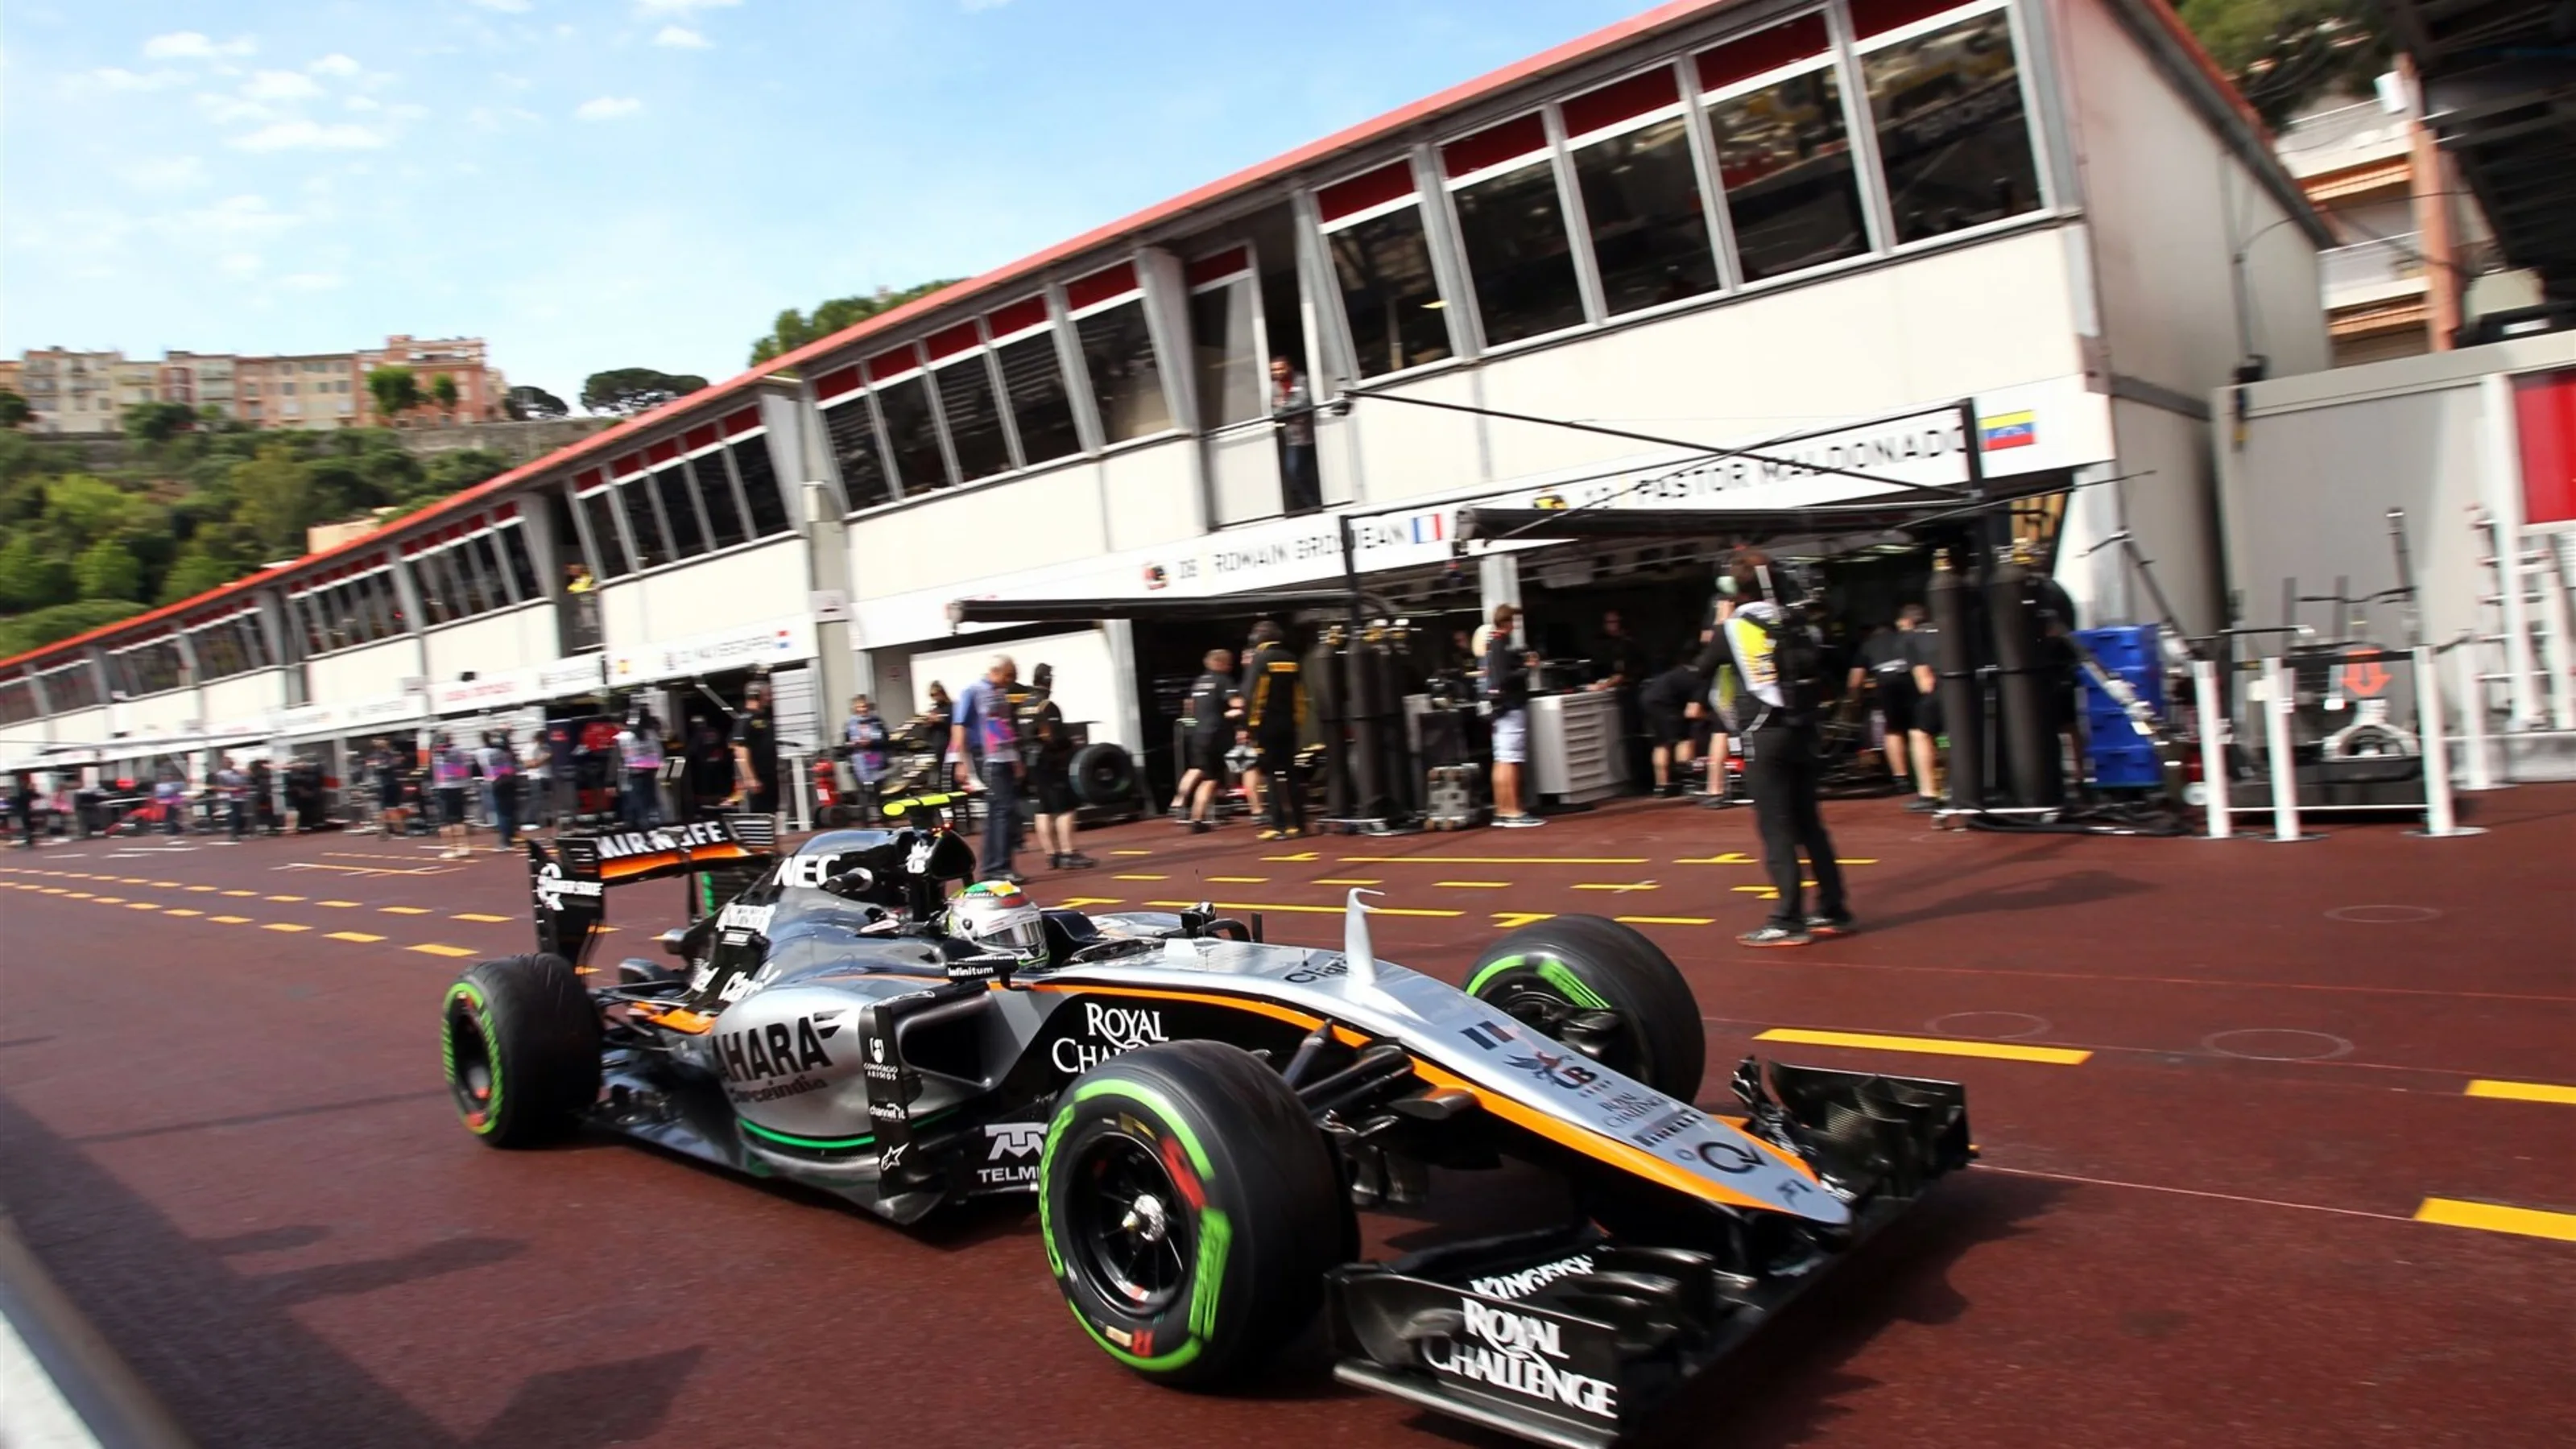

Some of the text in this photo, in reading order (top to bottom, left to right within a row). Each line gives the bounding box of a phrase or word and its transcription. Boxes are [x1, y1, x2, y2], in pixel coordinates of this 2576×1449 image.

[1637, 461, 1751, 504] PASTOR
[1296, 525, 1408, 560] GROJEAN
[773, 855, 841, 888] NEC
[1085, 1002, 1169, 1049] ROYAL
[1460, 1296, 1570, 1359] ROYAL
[1420, 1334, 1619, 1420] CHALLENGE
